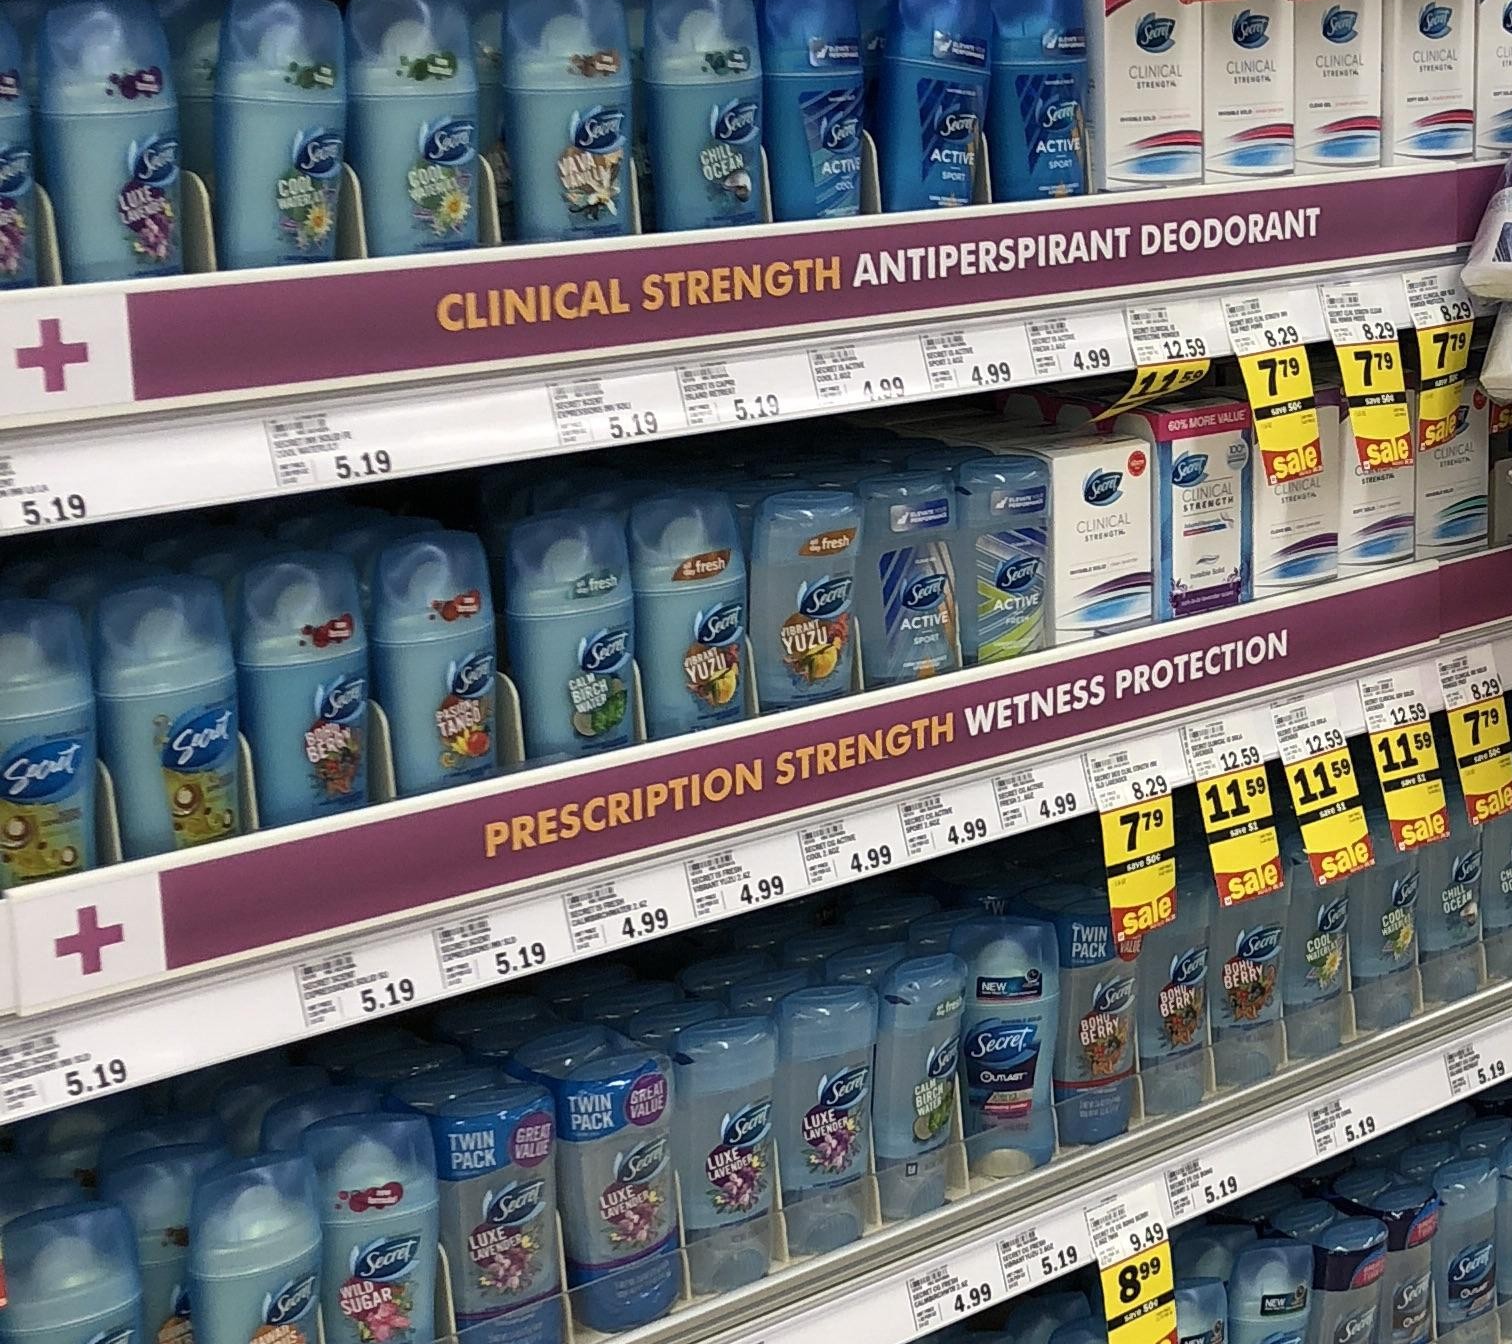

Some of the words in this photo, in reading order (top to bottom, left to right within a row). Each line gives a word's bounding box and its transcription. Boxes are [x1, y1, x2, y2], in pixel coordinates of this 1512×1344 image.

[1129, 64, 1183, 80] CLINICAL
[1226, 59, 1276, 74] CLINICAL
[1315, 54, 1364, 69] CLINICAL
[702, 158, 747, 183] OCEAN
[436, 278, 630, 333] CLINICAL
[642, 256, 842, 311] STRENGTH
[853, 226, 1131, 288] ANTIPERSPIRANT
[1141, 207, 1321, 256] DEODORANT
[1440, 301, 1472, 322] 8.29
[1264, 325, 1299, 348] 8.29
[1362, 318, 1395, 341] 8.29
[1163, 337, 1206, 360] 12.59
[971, 361, 1012, 385] 4.99
[1190, 415, 1216, 429] MORE
[1217, 410, 1246, 426] VALUE
[335, 449, 392, 480] 5.19
[1272, 444, 1319, 480] sale
[22, 493, 86, 526] 5.19
[1183, 496, 1235, 513] STRENGTH
[821, 534, 851, 550] fresh
[993, 592, 1040, 613] ACTIVE
[781, 619, 819, 638] VIBRANT
[901, 612, 949, 630] ACTIVE
[781, 628, 829, 655] YUZU
[686, 656, 727, 684] YUZU
[485, 759, 764, 857] PRESCRIPTION
[776, 713, 955, 783] STRENGTH
[965, 672, 1106, 737] WETNESS
[1115, 629, 1289, 700] PROTECTION
[496, 942, 547, 976] 5.19
[361, 979, 416, 1013] 5.19
[981, 982, 1007, 993] NEW
[970, 1031, 1027, 1058] Secret
[66, 1059, 128, 1096] 5.19
[568, 1093, 614, 1115] TWIN
[629, 1083, 664, 1104] GREAT
[629, 1098, 664, 1119] VALUE
[570, 1112, 615, 1131] PACK
[803, 1109, 836, 1131] LUXE
[448, 1131, 496, 1153] TWIN
[515, 1124, 551, 1146] GREAT
[451, 1149, 496, 1171] PACK
[514, 1138, 550, 1161] VALUE
[707, 1146, 740, 1168] LUXE
[1131, 1224, 1164, 1252] 9.49
[339, 1282, 374, 1301] WILD
[340, 1288, 392, 1316] SUGAR
